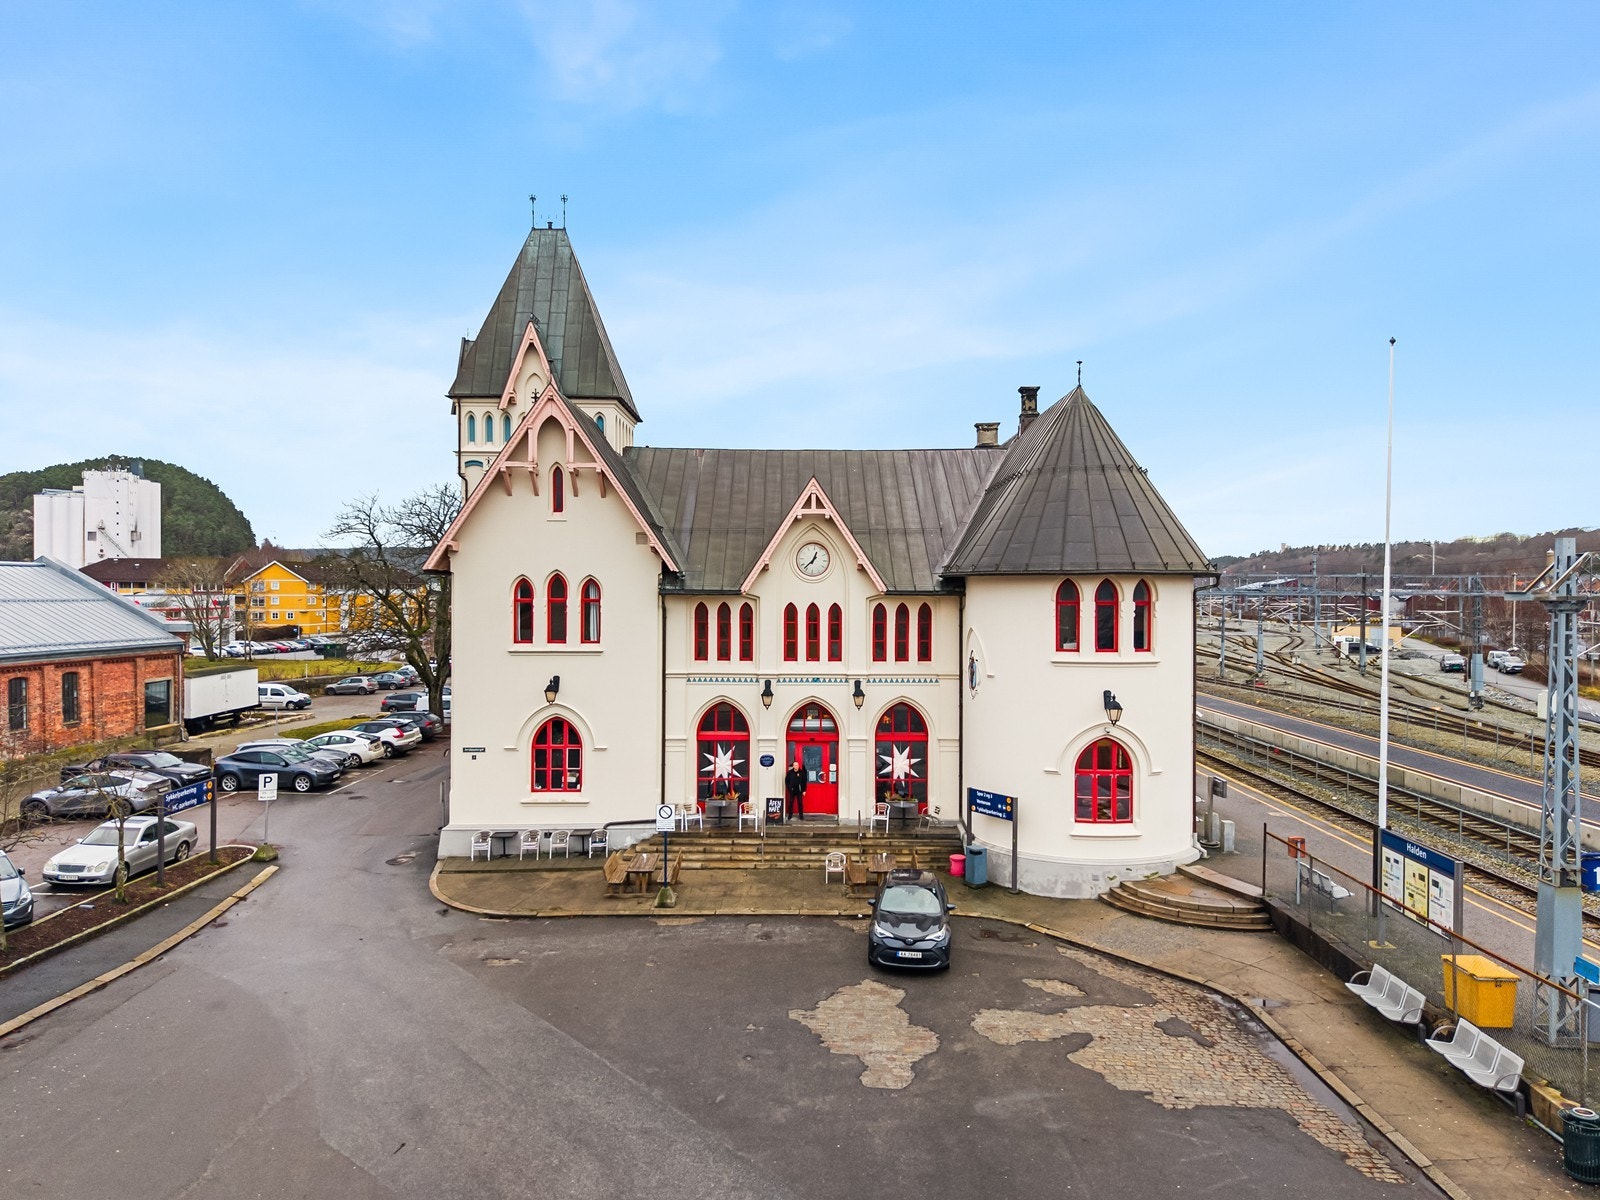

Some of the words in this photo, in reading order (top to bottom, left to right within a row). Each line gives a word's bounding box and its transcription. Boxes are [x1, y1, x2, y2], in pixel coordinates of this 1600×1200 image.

[264, 776, 273, 788] P
[165, 787, 197, 802] Sykkelparkering
[1406, 843, 1427, 859] Halden
